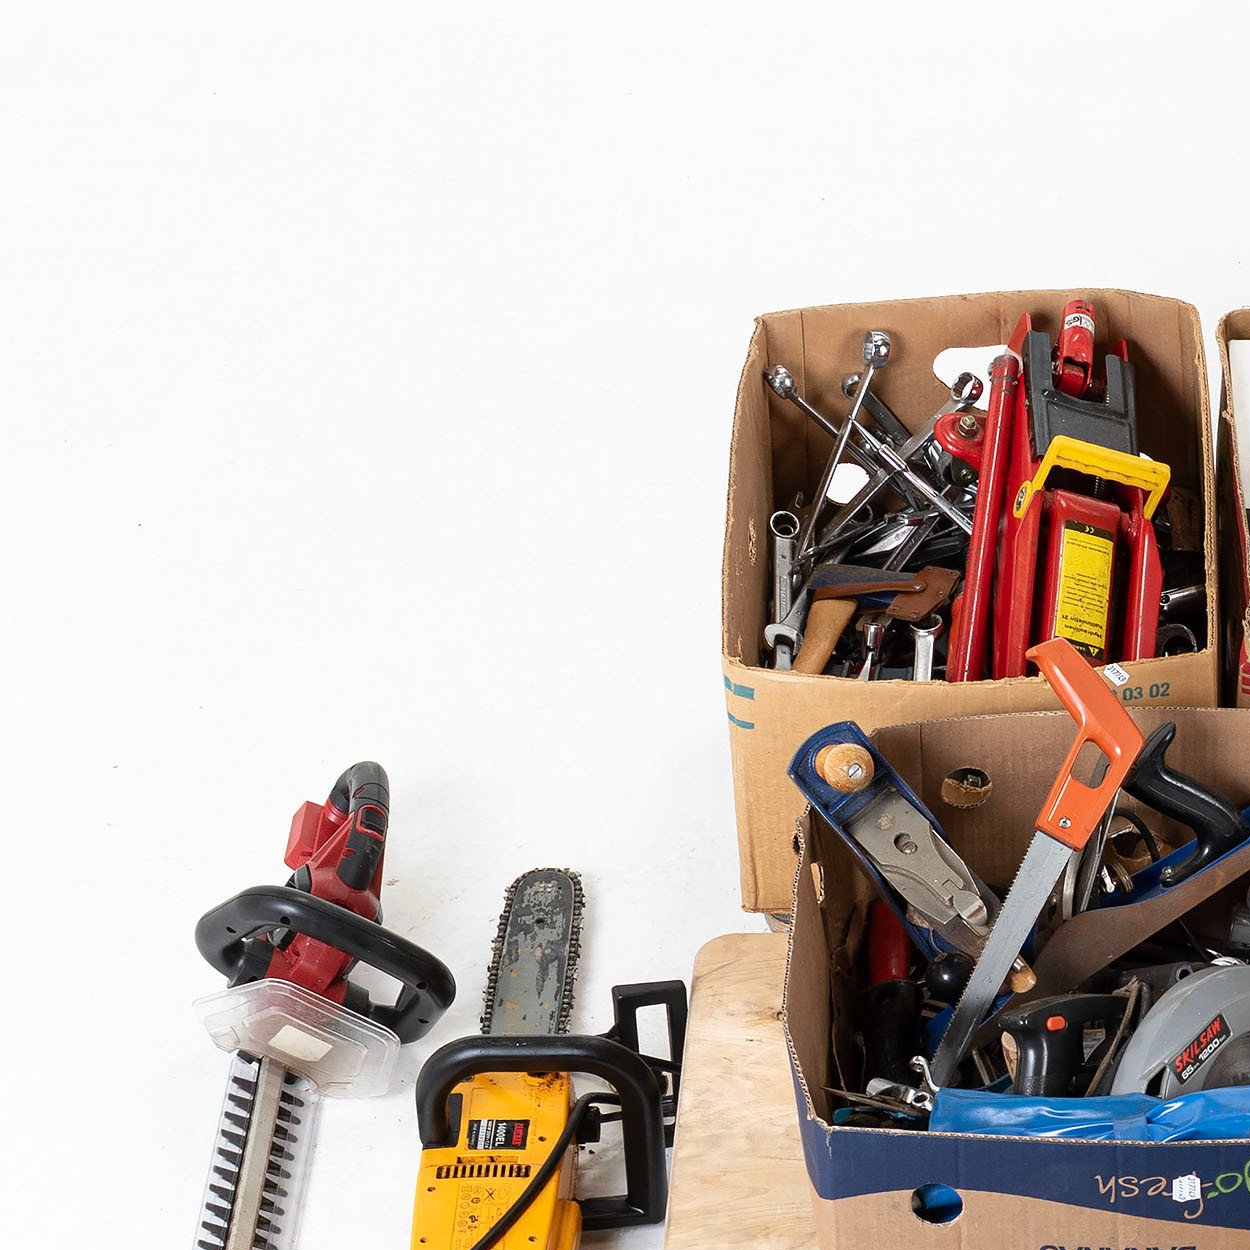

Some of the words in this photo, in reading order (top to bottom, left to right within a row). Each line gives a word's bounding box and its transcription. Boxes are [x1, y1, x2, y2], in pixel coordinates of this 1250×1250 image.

[1122, 686, 1144, 701] 03
[1149, 682, 1171, 698] 02
[1175, 1016, 1222, 1073] SKILSAW
[1181, 1064, 1195, 1080] 65
[1198, 1037, 1220, 1061] 1200
[495, 1122, 507, 1147] 1400EL
